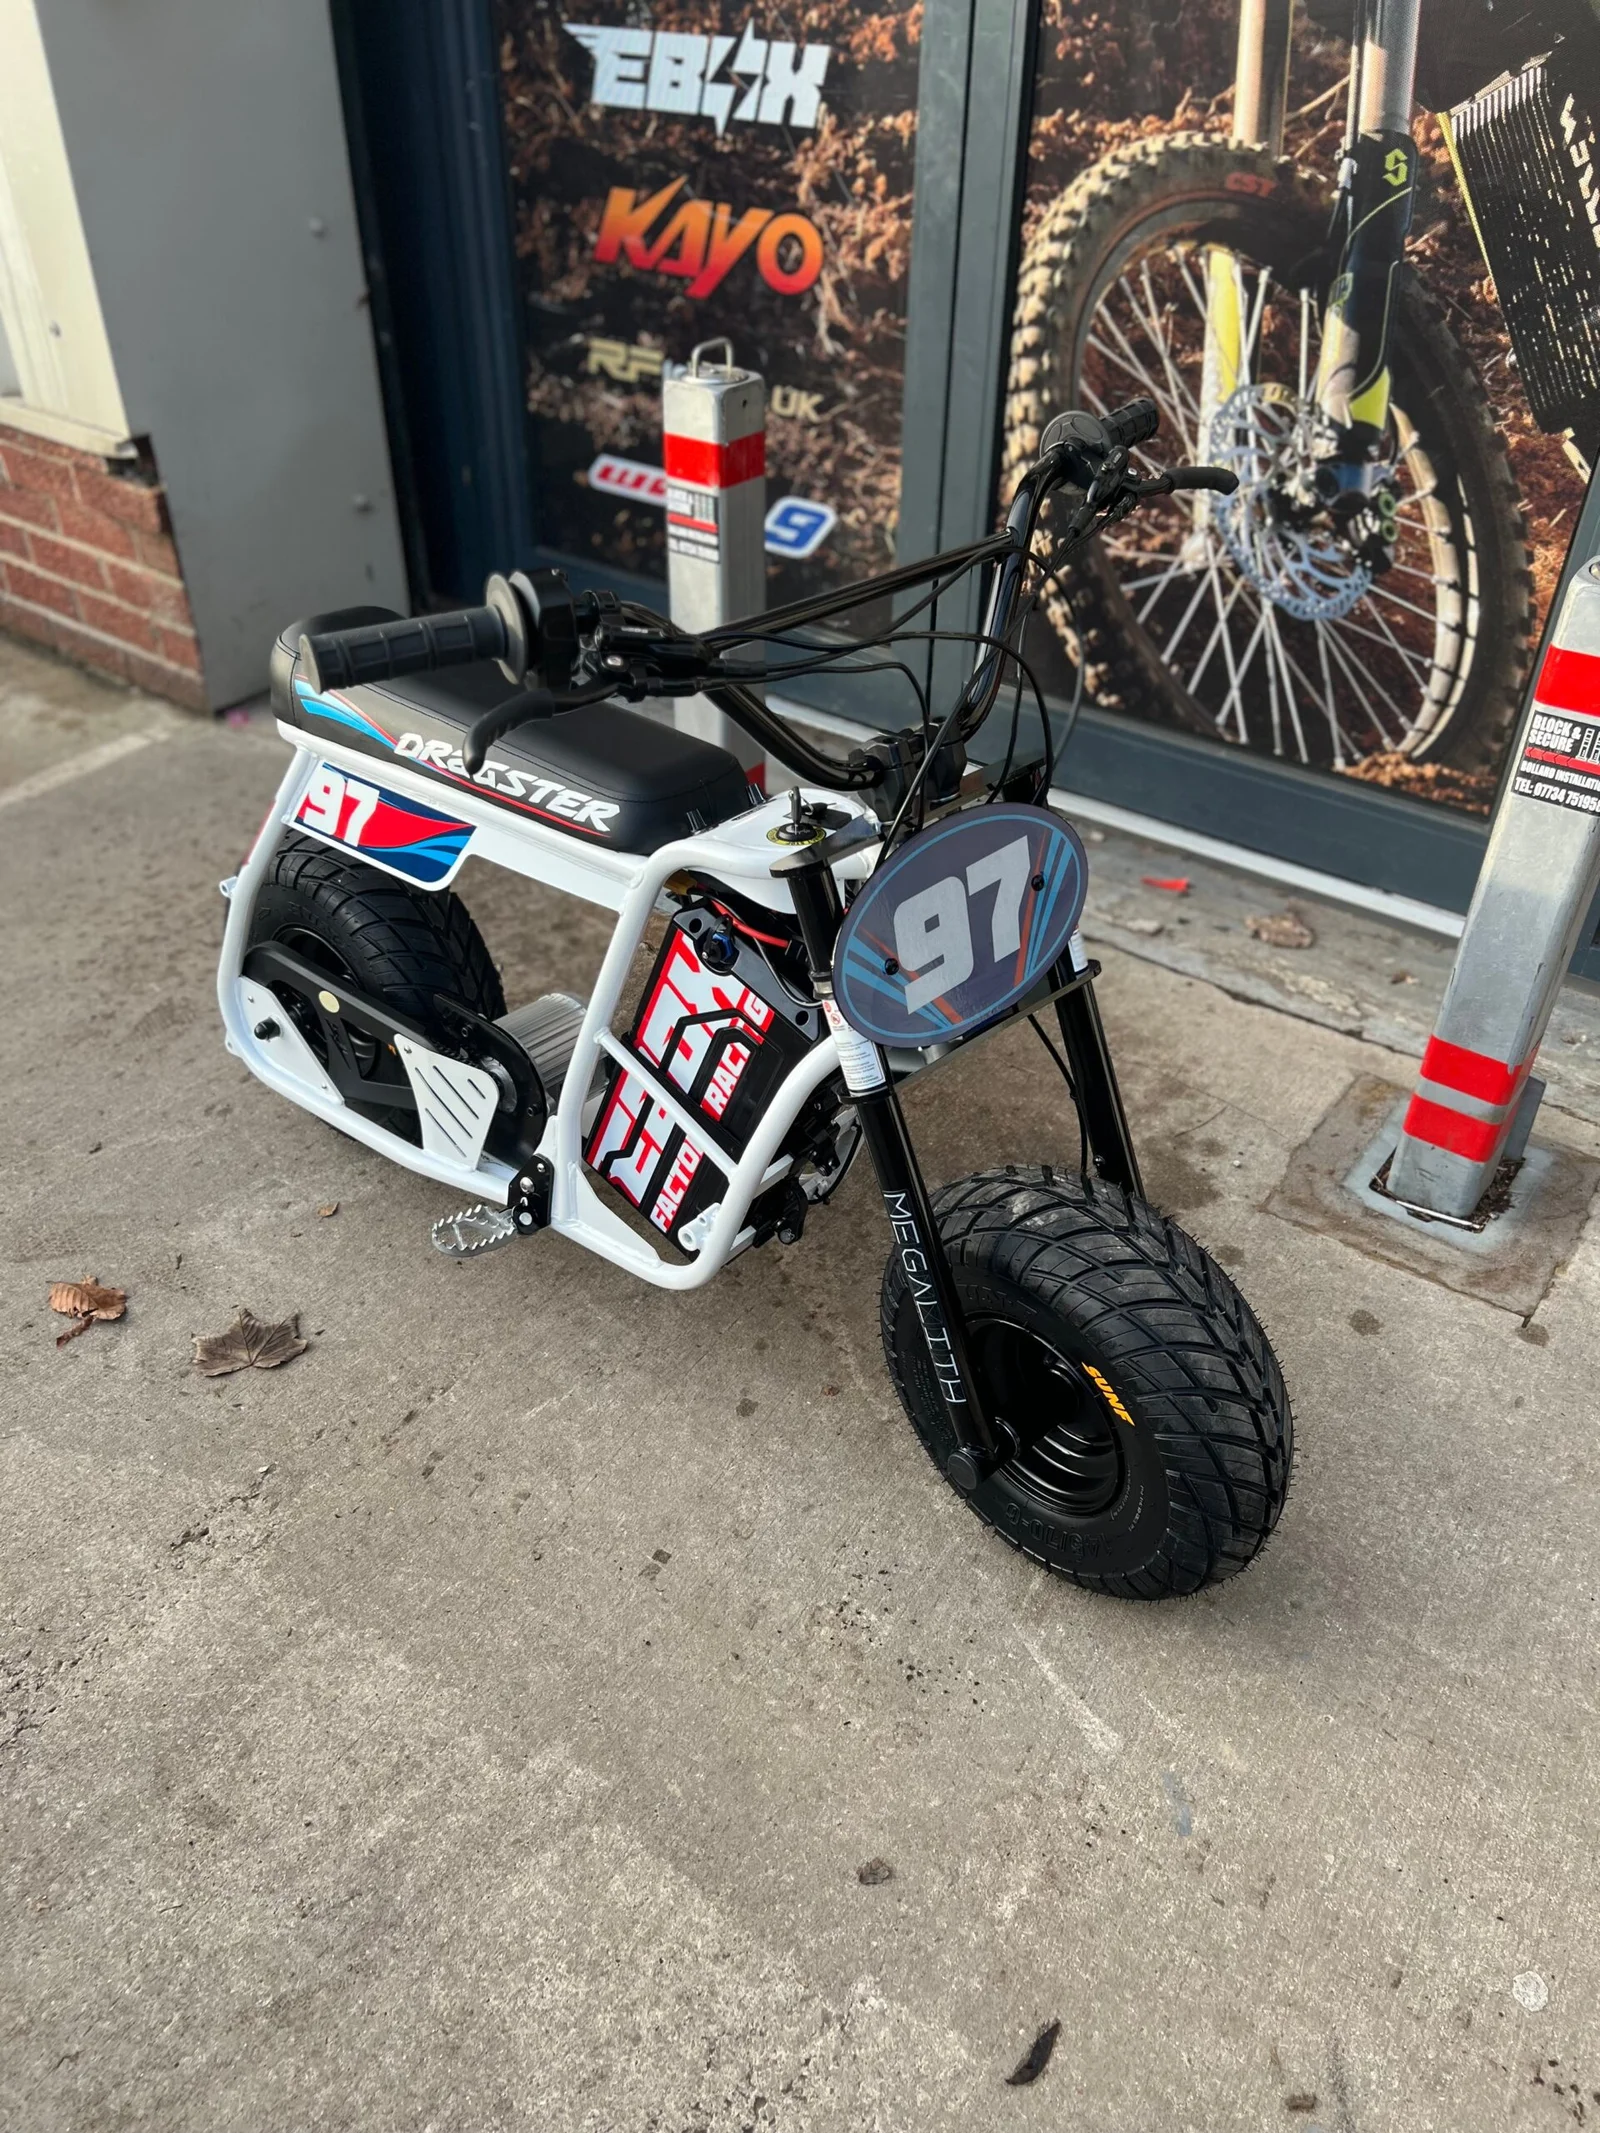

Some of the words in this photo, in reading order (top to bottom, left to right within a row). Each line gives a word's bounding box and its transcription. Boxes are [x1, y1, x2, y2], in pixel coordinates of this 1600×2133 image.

[1225, 171, 1277, 197] CST
[594, 174, 825, 299] KAYO
[771, 385, 825, 422] UK
[1528, 729, 1575, 753] SECURE
[1532, 713, 1574, 738] BLOCK
[1571, 726, 1582, 740] &
[1514, 776, 1534, 795] TEL:
[1533, 781, 1566, 803] 07734
[1520, 760, 1556, 780] BOLLARD
[302, 768, 381, 847] 97
[893, 834, 1032, 1016] 97
[702, 990, 769, 1118] RACIG
[883, 1190, 967, 1404] MEGALITH
[1081, 1361, 1136, 1427] SUNF
